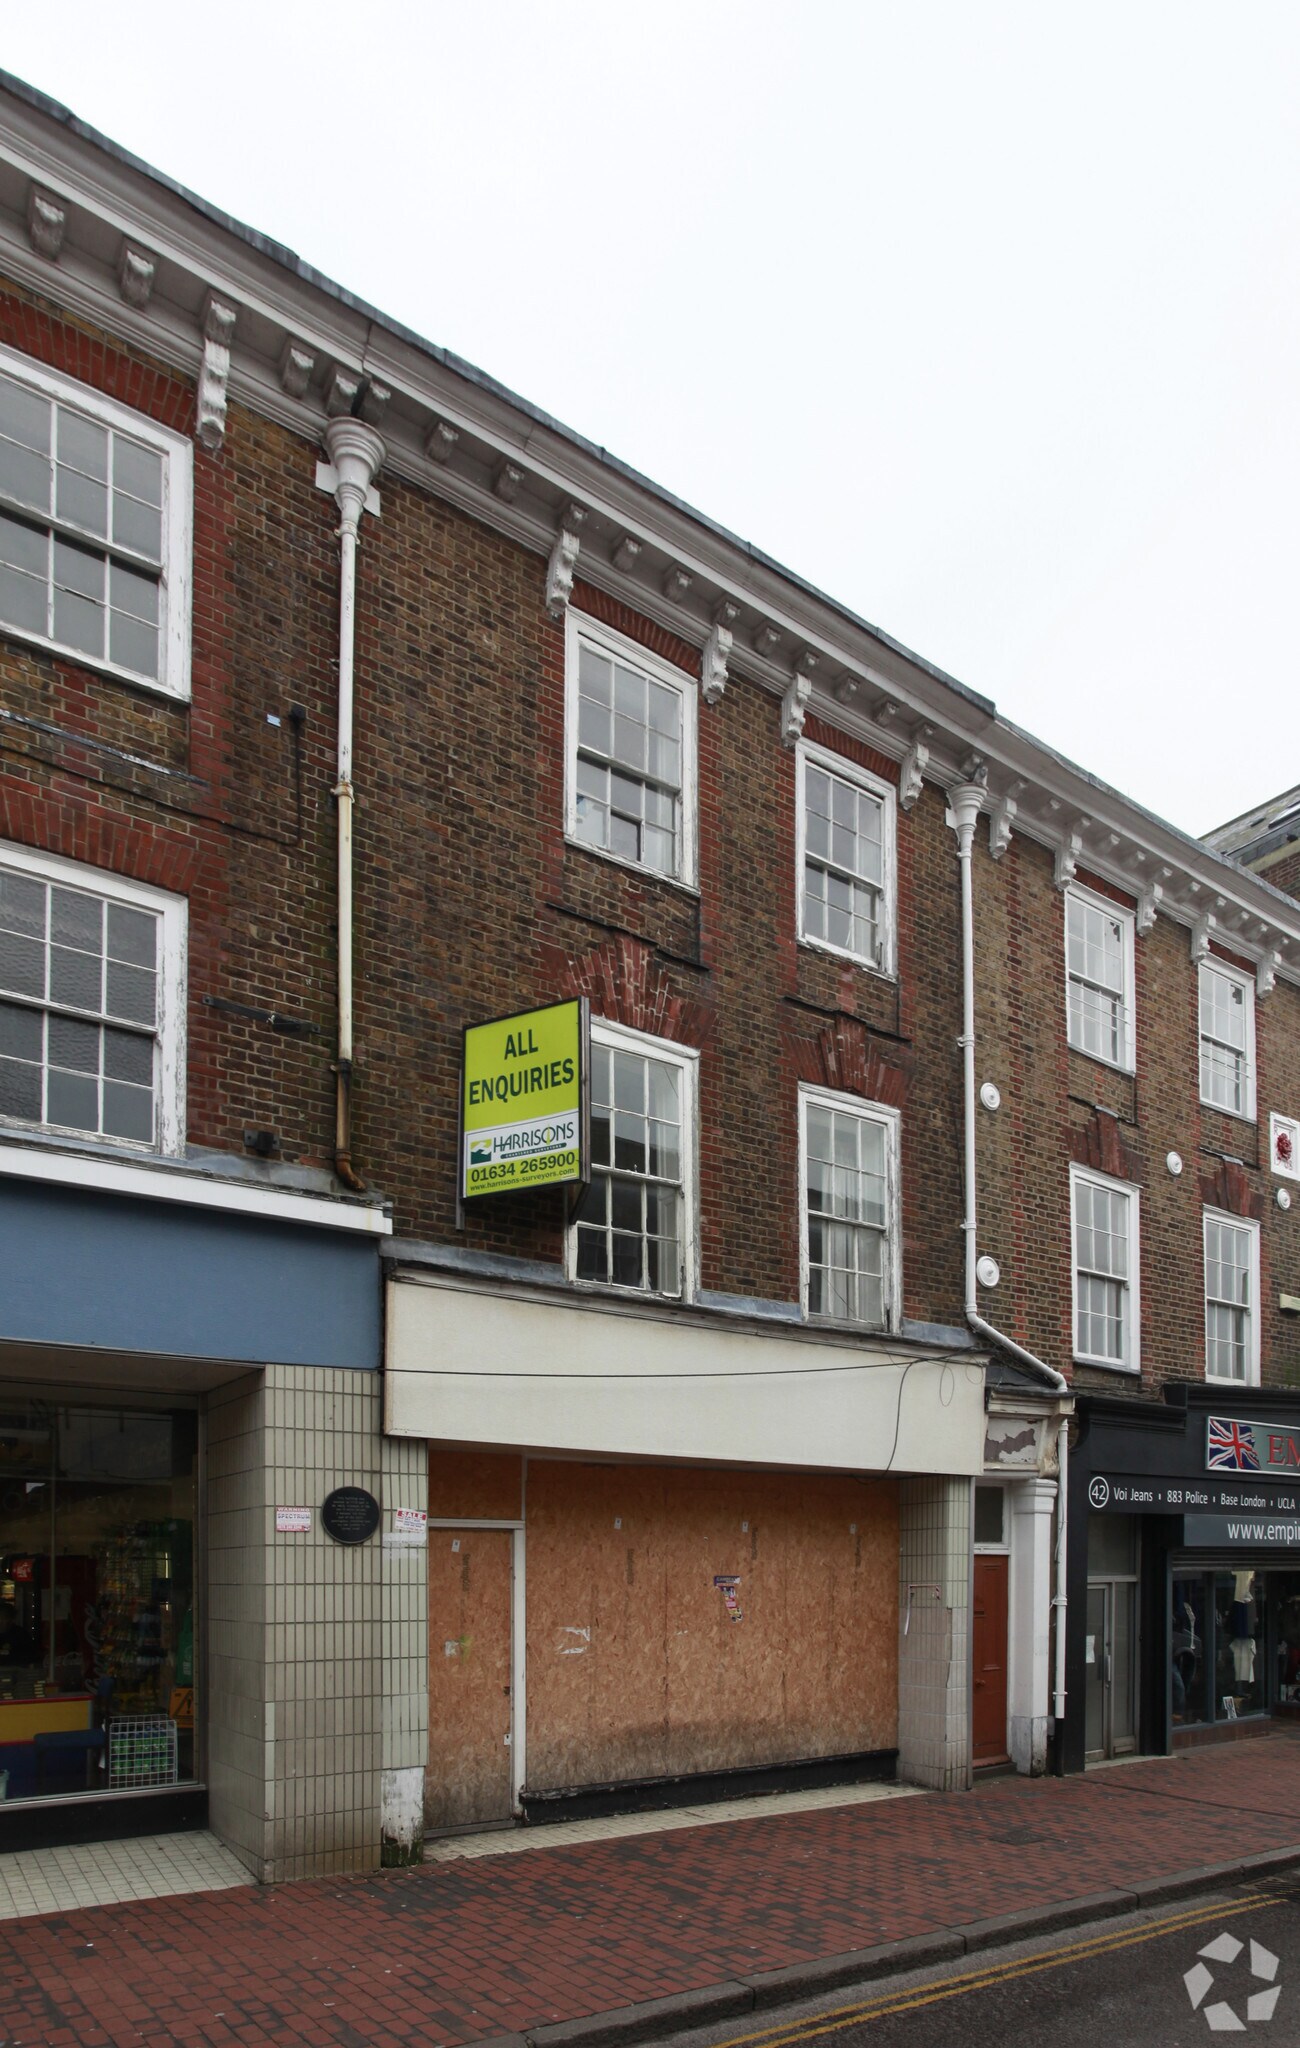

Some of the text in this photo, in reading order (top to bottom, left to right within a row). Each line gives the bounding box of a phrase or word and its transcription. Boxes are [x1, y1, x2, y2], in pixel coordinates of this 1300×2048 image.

[504, 1029, 538, 1060] ALL
[469, 1058, 574, 1105] ENQUIRIES
[493, 1122, 574, 1153] HARRISONS
[470, 1168, 575, 1191] www.harrisons-surveyors.com
[471, 1152, 575, 1182] 01634 265900
[1091, 1485, 1296, 1509] 42 Voi Jeans 883 Police Base London UCLA
[1227, 1521, 1300, 1545] www.empi
